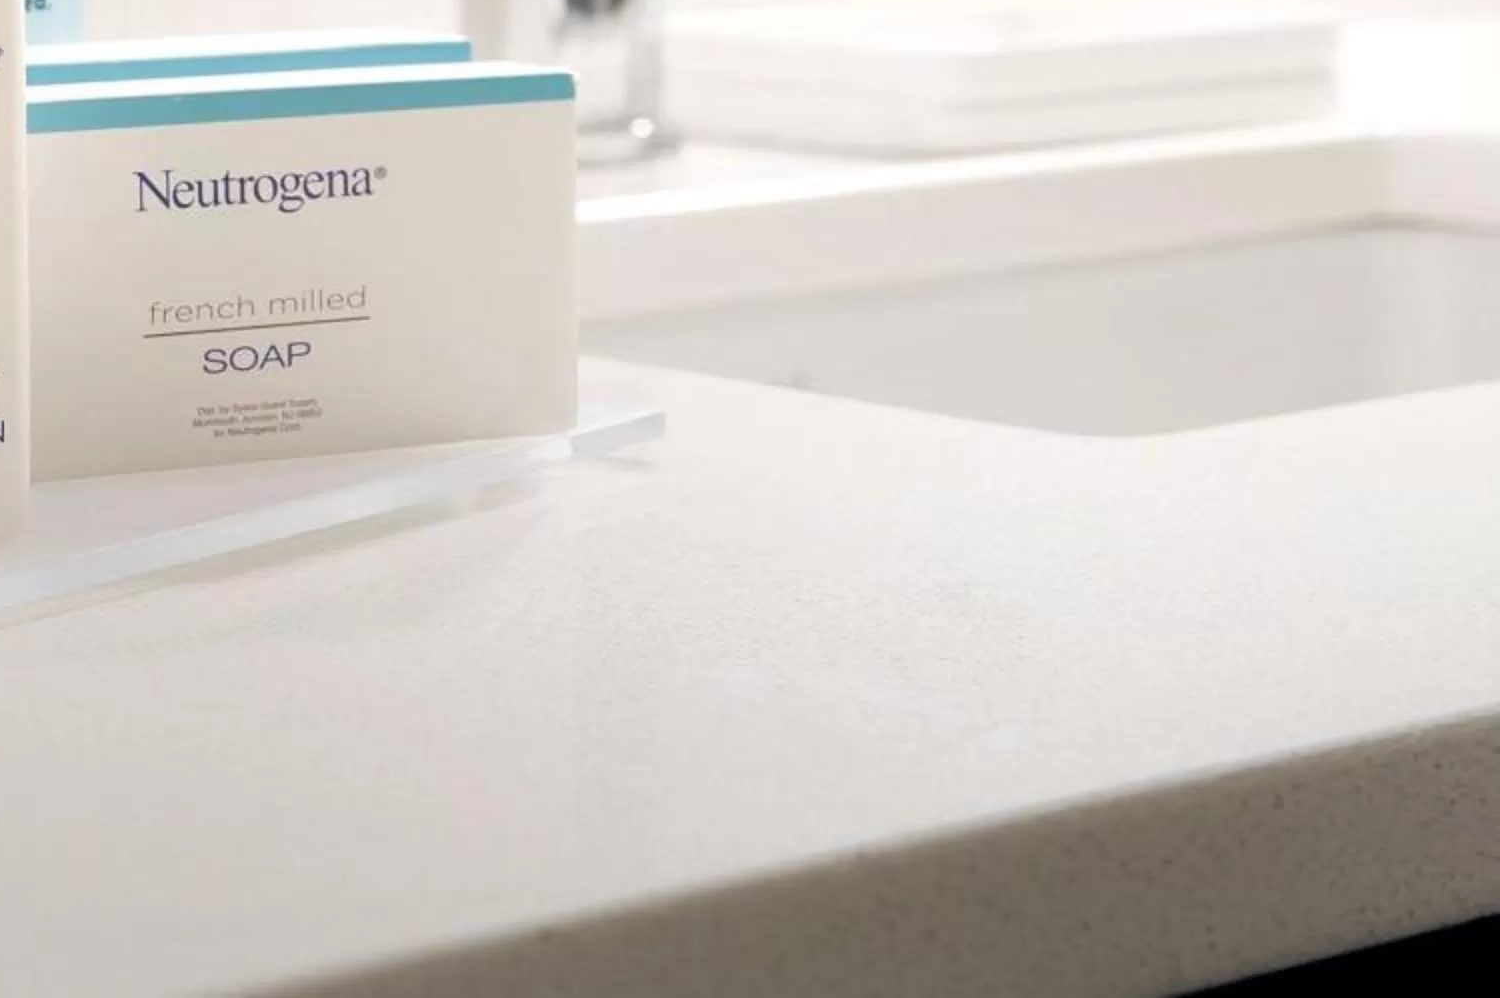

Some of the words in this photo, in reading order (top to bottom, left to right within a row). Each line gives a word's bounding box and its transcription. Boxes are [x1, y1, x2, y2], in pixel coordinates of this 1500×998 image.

[148, 294, 256, 326] french
[267, 285, 368, 315] milled
[202, 341, 312, 375] SOAP
